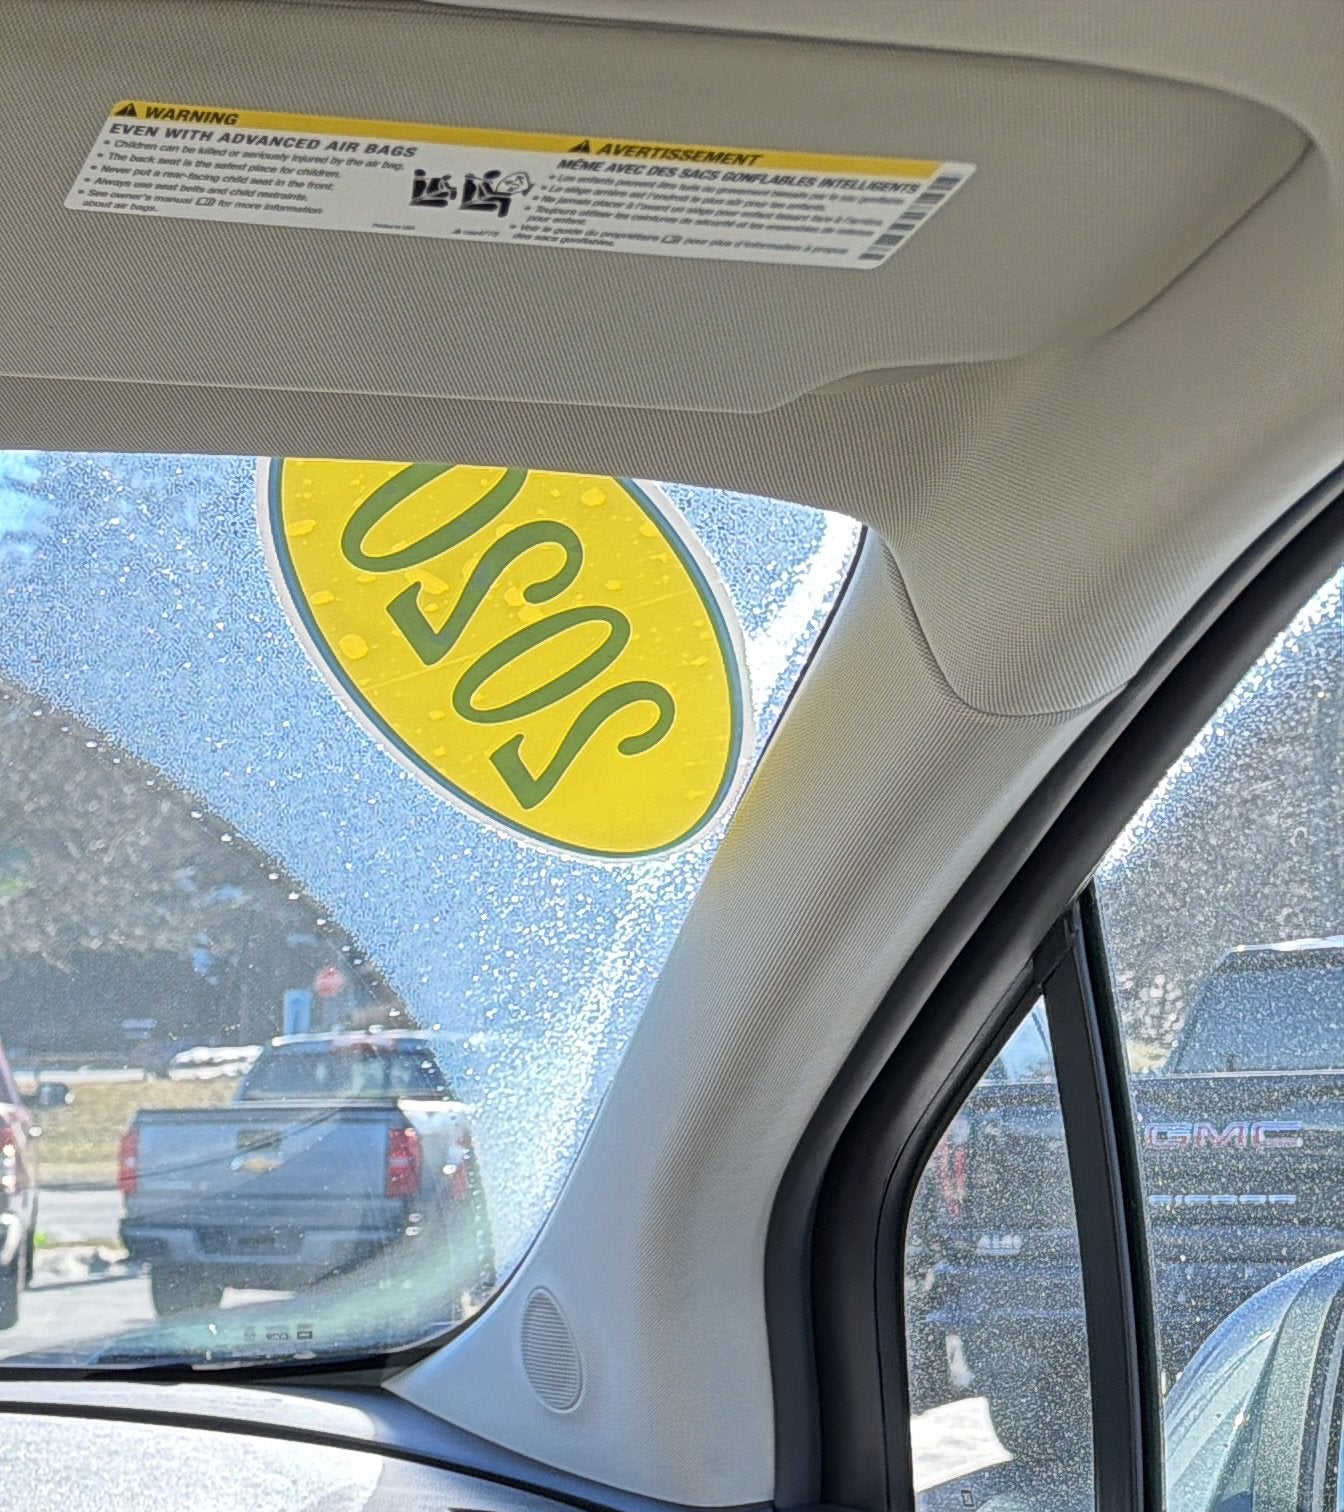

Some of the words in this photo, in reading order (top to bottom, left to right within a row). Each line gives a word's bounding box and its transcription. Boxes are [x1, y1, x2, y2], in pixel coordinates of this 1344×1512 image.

[145, 106, 239, 125] WARNING
[109, 123, 160, 137] EVEN
[165, 127, 213, 141] WITH
[216, 133, 320, 150] ADVANCED
[324, 141, 360, 152] AIR
[364, 144, 418, 157] BAGS
[108, 152, 127, 161] The
[130, 154, 156, 164] back
[157, 158, 181, 166] seat
[195, 160, 212, 168] the
[248, 164, 277, 174] place
[279, 166, 295, 174] for
[114, 140, 157, 150] Children
[182, 146, 196, 154] be
[197, 146, 227, 156] killed
[241, 151, 290, 162] seriously
[291, 154, 329, 164] injured
[330, 156, 344, 166] by
[345, 158, 364, 167] the
[364, 160, 380, 168] air
[595, 143, 762, 166] AVERTISSEMENT
[93, 177, 132, 188] Always
[154, 183, 178, 191] seat
[180, 185, 206, 193] belts
[229, 188, 256, 197] child
[100, 164, 132, 174] Never
[162, 171, 220, 183] rear-facing
[222, 176, 249, 184] child
[250, 178, 274, 186] seat
[274, 179, 285, 187] in
[287, 180, 305, 188] the
[556, 158, 604, 172] MÊME
[604, 163, 646, 175] AVEC
[646, 166, 678, 178] DES
[678, 168, 720, 181] SACS
[720, 172, 817, 187] GONFLABLES
[817, 178, 922, 194] INTELLIGENTS
[87, 189, 108, 198] See
[153, 195, 194, 204] manual
[217, 199, 232, 208] for
[234, 202, 262, 210] more
[263, 204, 323, 214] information
[1145, 1121, 1302, 1148] GMC
